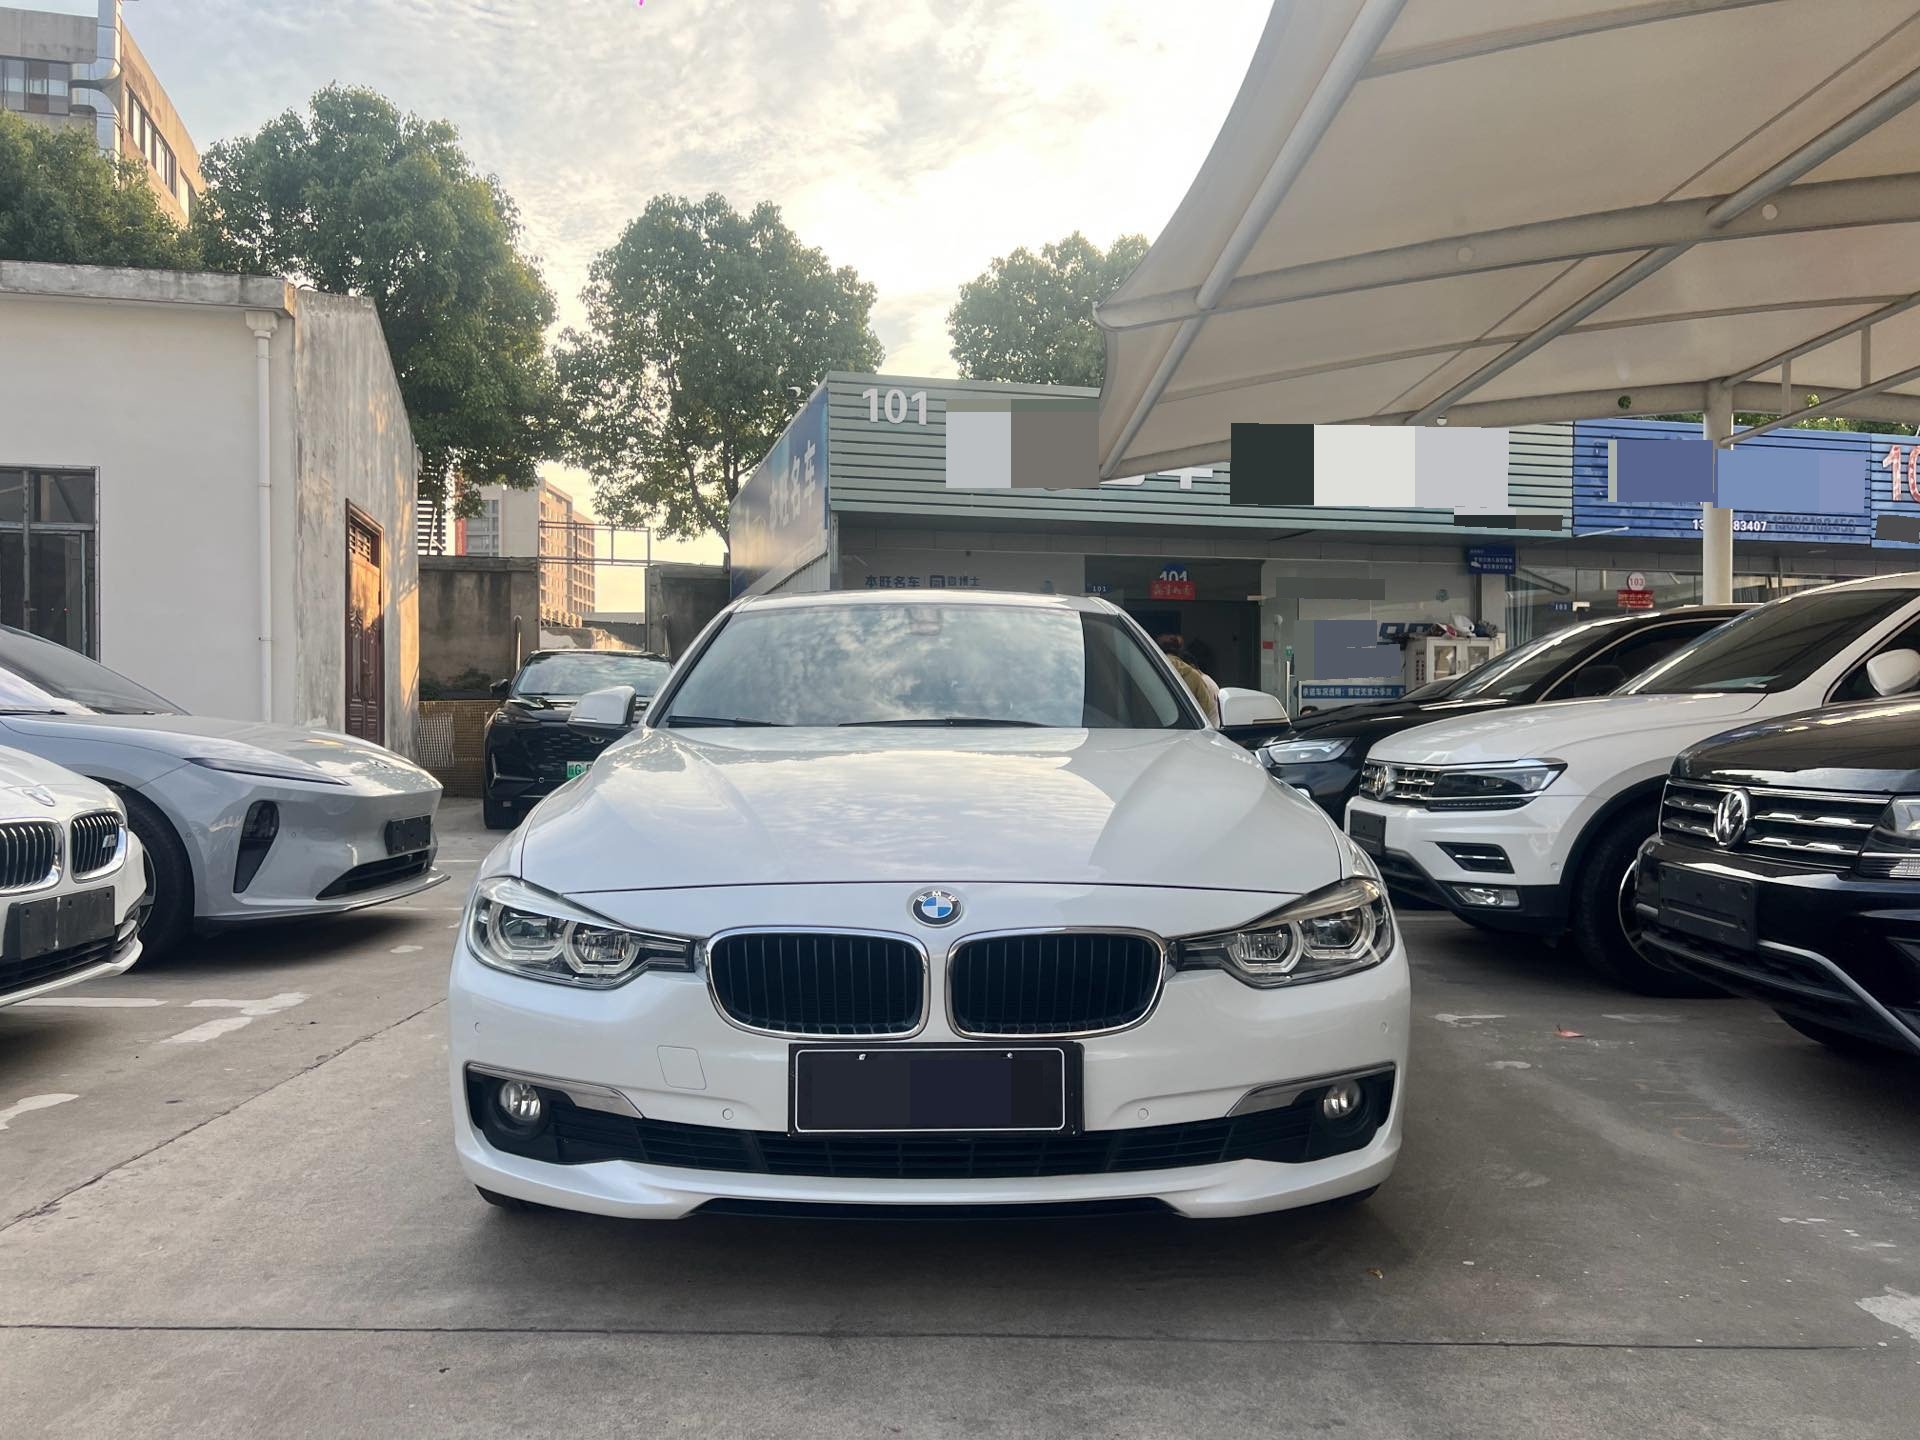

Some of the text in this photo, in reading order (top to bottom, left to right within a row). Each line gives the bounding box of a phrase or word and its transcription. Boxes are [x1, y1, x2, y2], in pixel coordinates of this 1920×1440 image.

[862, 388, 927, 426] 101
[865, 575, 920, 588] 本旺名车
